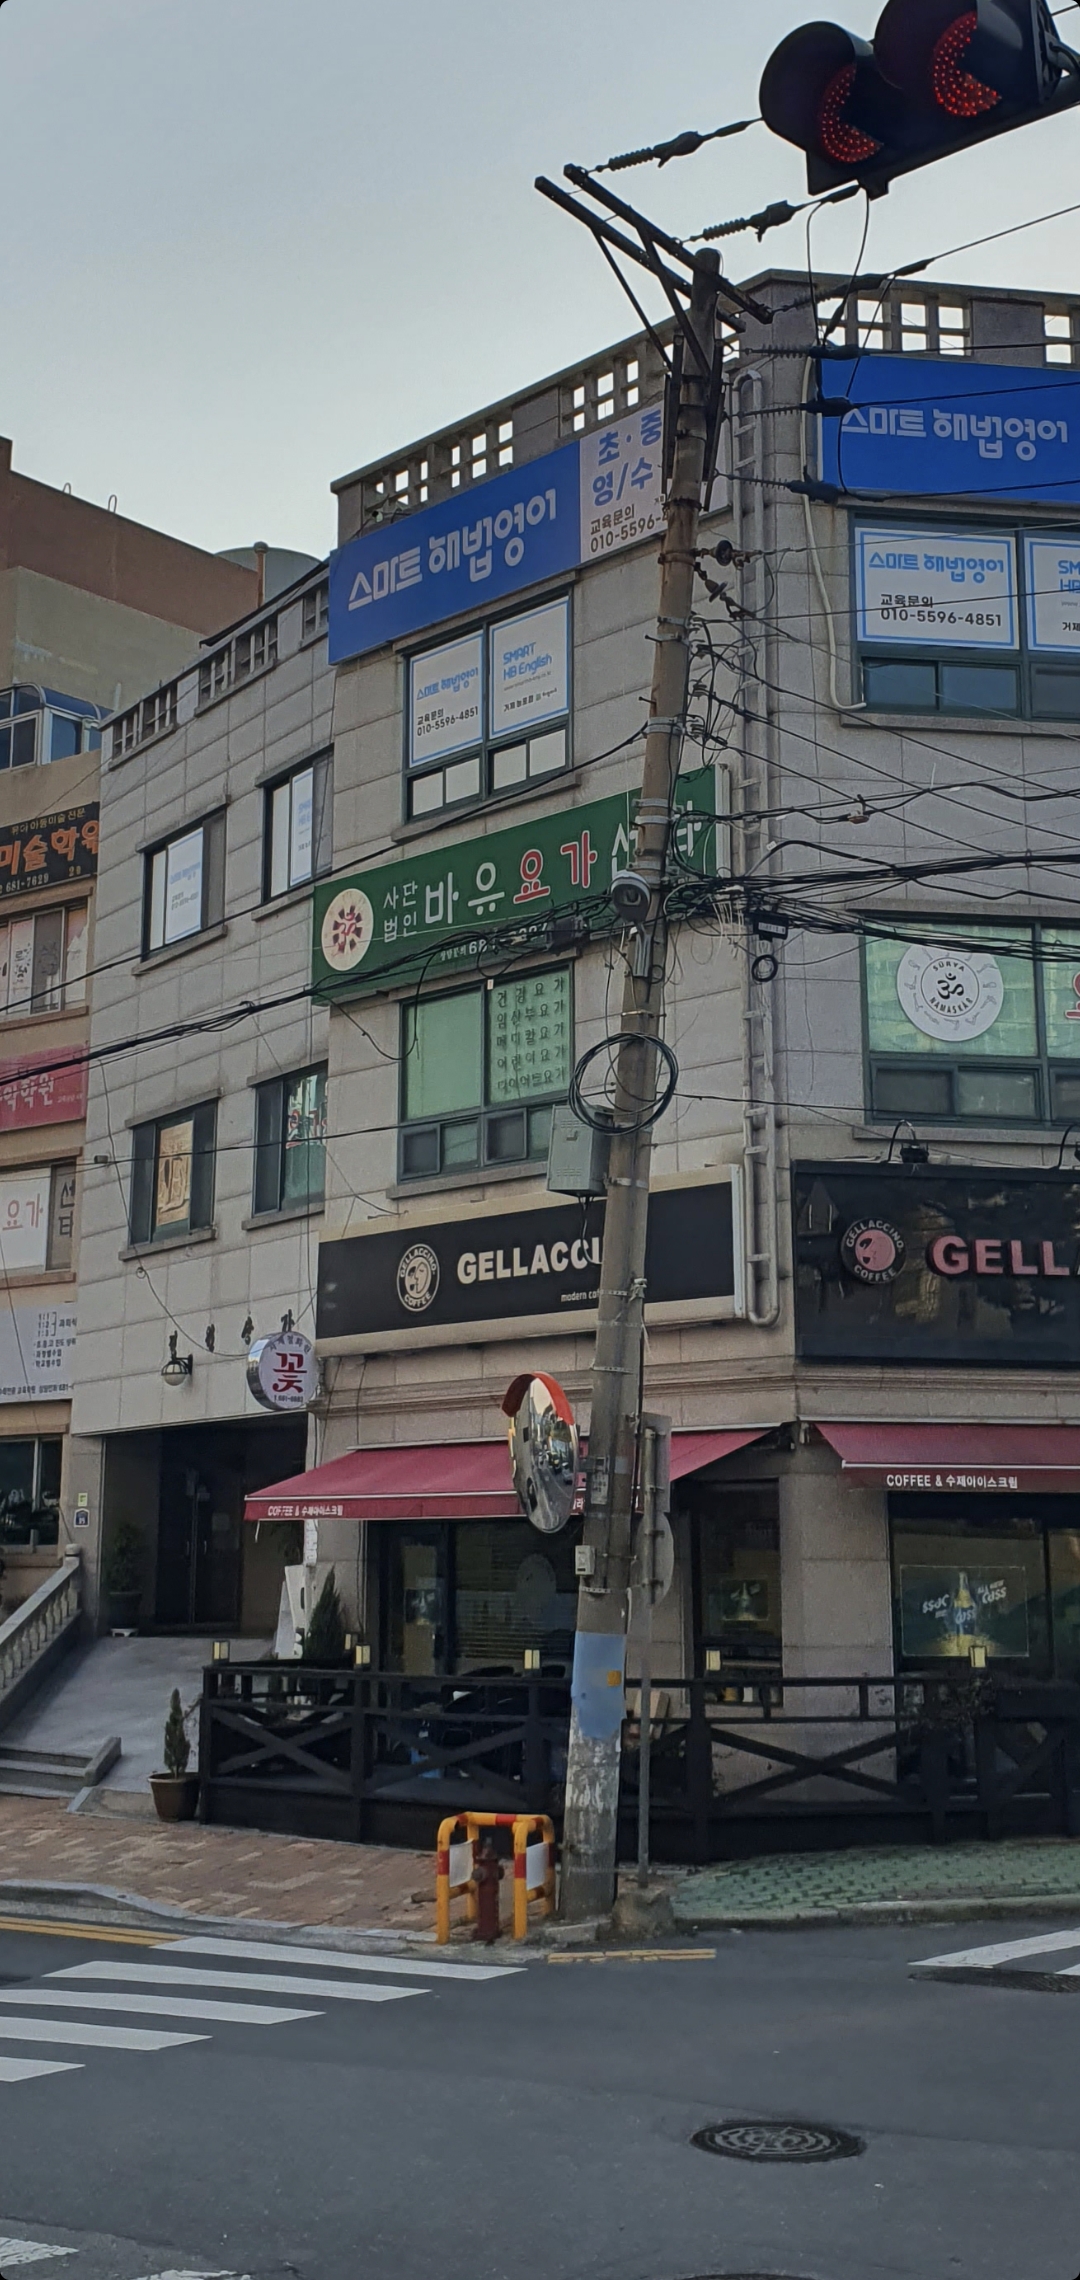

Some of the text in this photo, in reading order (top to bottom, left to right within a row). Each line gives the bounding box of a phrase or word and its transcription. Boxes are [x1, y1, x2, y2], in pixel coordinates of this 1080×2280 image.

[841, 408, 1068, 461] 스마트 해법영어
[592, 456, 653, 507] 영/수
[590, 503, 635, 536] 교육문의
[348, 488, 557, 612] 스마트 해법영어
[868, 552, 1004, 584] 스마트 해법영어
[880, 594, 934, 609] 교육문의
[880, 608, 1002, 627] 010-5596-4851
[502, 642, 537, 666] SMART
[503, 665, 517, 681] HB
[518, 653, 553, 676] English
[416, 681, 440, 701] 스마트
[416, 705, 479, 737] 010-5596-4851
[417, 707, 444, 726] 교육문의
[512, 829, 599, 905] 요가
[5, 873, 50, 893] 681-7629
[383, 881, 418, 910] 사단
[383, 911, 418, 943] 법인
[2, 1192, 44, 1231] 요가
[845, 1219, 904, 1248] GELLACCINO
[932, 1235, 1080, 1276] GELL
[853, 1263, 897, 1282] COFFEE
[560, 1289, 587, 1303] modern
[272, 1352, 308, 1394] 꽃
[886, 1474, 932, 1487] COFFEE
[935, 1474, 943, 1487] &
[267, 1505, 294, 1517] COFFEE
